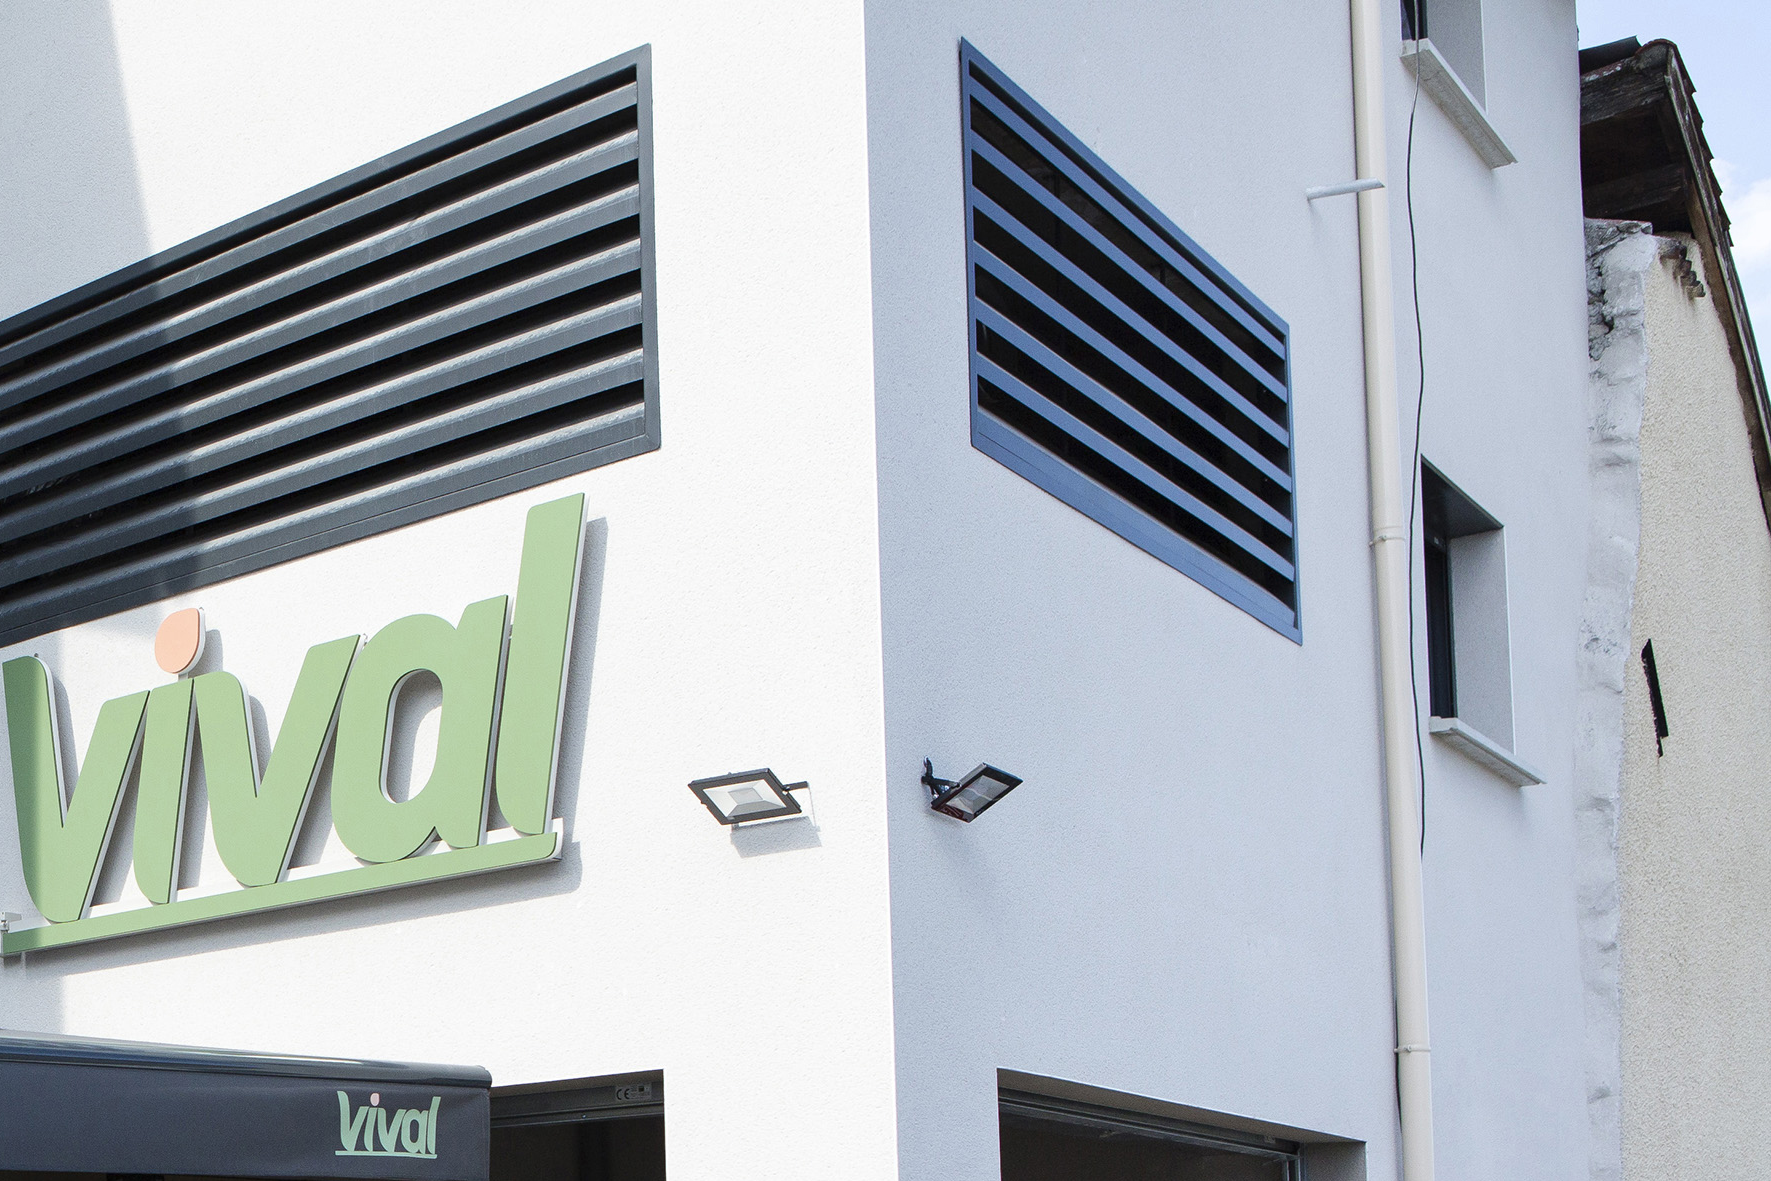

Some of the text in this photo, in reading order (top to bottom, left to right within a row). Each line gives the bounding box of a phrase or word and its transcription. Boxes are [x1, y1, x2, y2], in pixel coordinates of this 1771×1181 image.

[2, 492, 586, 924] Vival
[336, 1090, 442, 1155] Vival
[616, 1088, 630, 1100] CE
